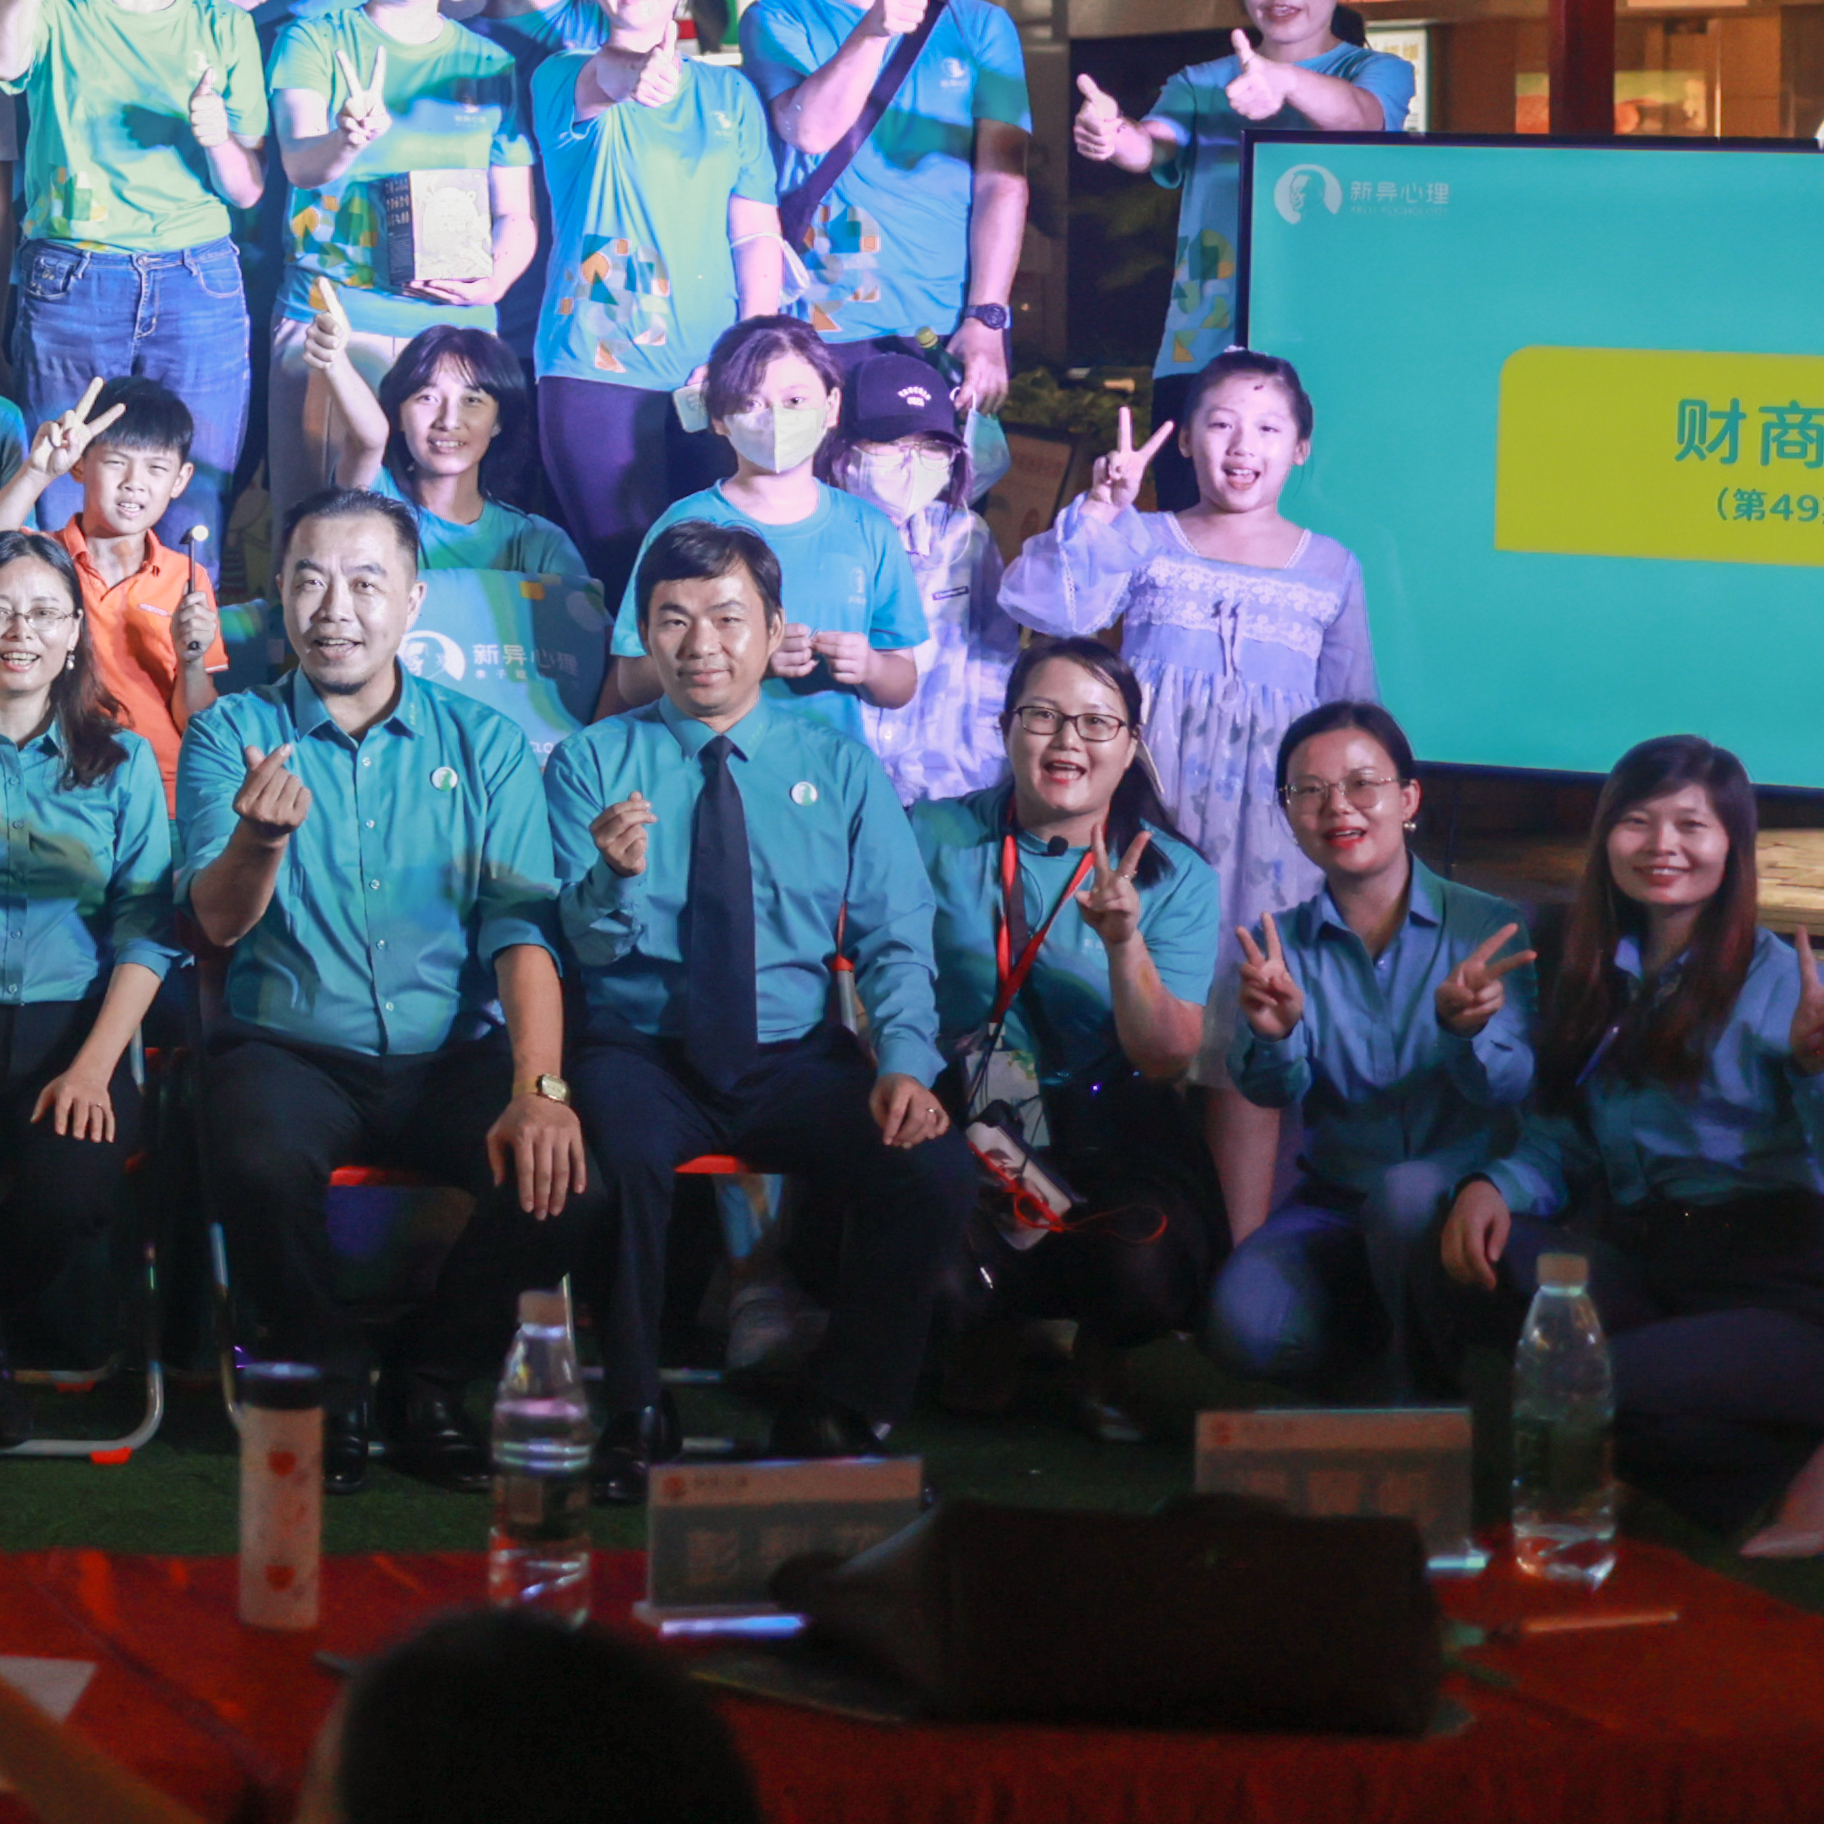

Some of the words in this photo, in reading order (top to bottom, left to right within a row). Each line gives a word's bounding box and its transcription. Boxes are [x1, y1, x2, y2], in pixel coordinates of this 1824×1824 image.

[1350, 180, 1450, 204] 新异心理
[1716, 487, 1824, 523] （第49
